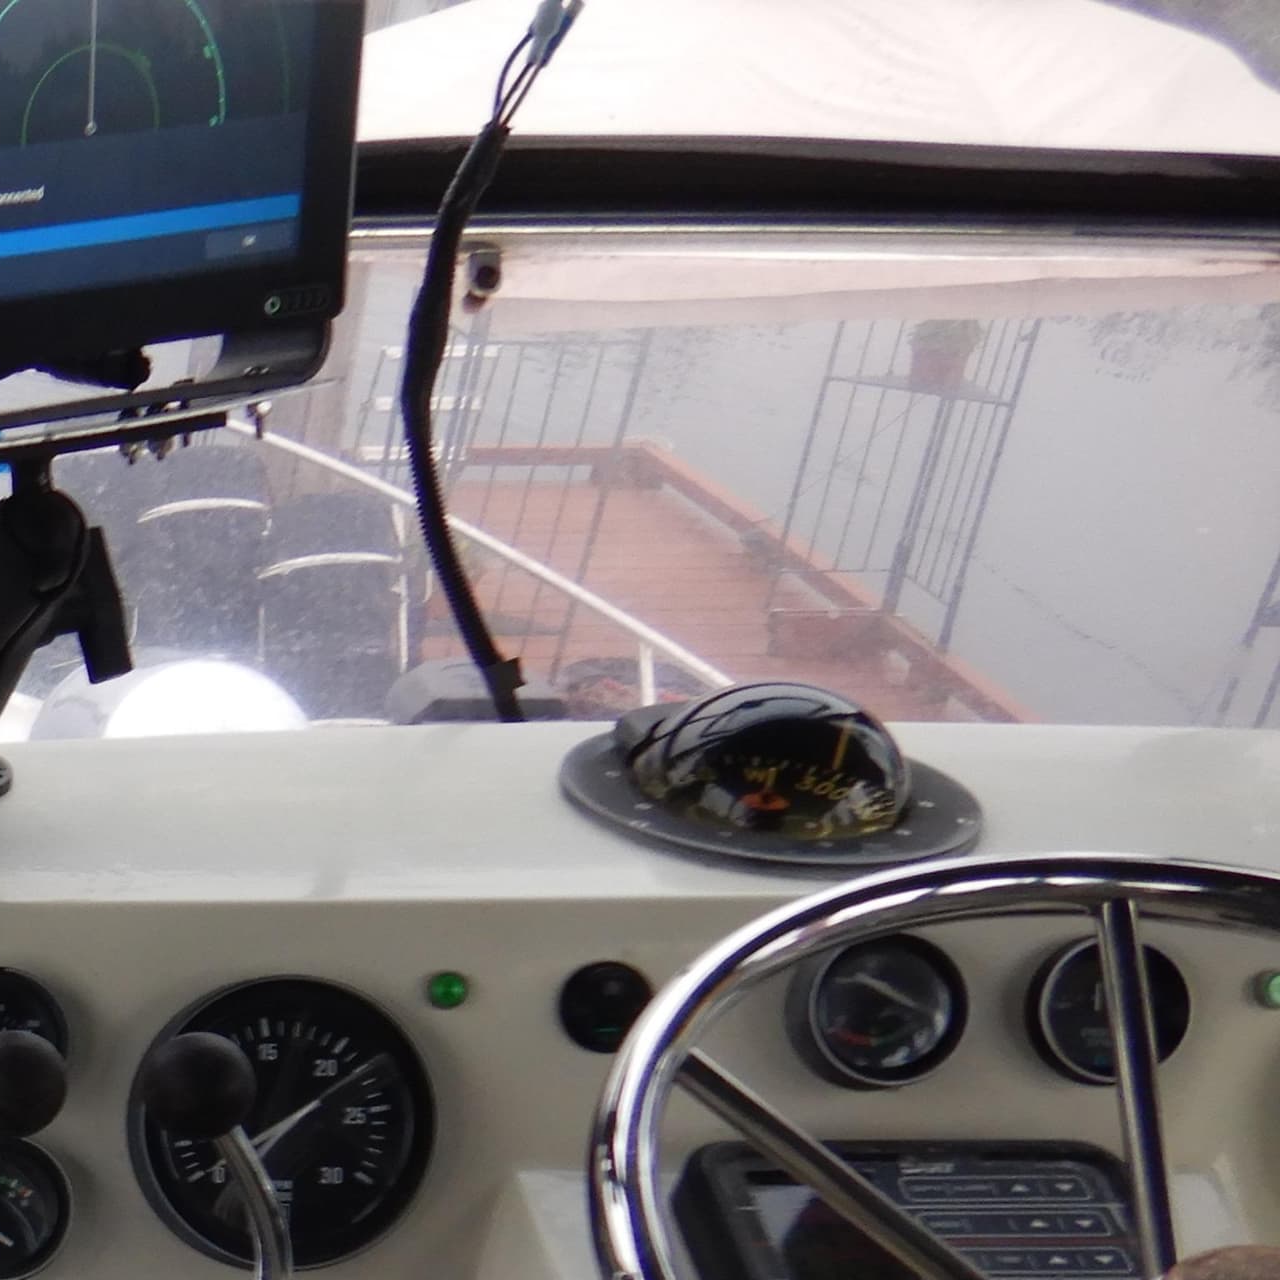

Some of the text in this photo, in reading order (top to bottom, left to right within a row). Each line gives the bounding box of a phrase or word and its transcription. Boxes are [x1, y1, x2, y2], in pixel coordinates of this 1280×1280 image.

[257, 1043, 279, 1061] 15
[312, 1058, 338, 1077] 20
[341, 1106, 367, 1125] 25
[319, 1166, 345, 1184] 30
